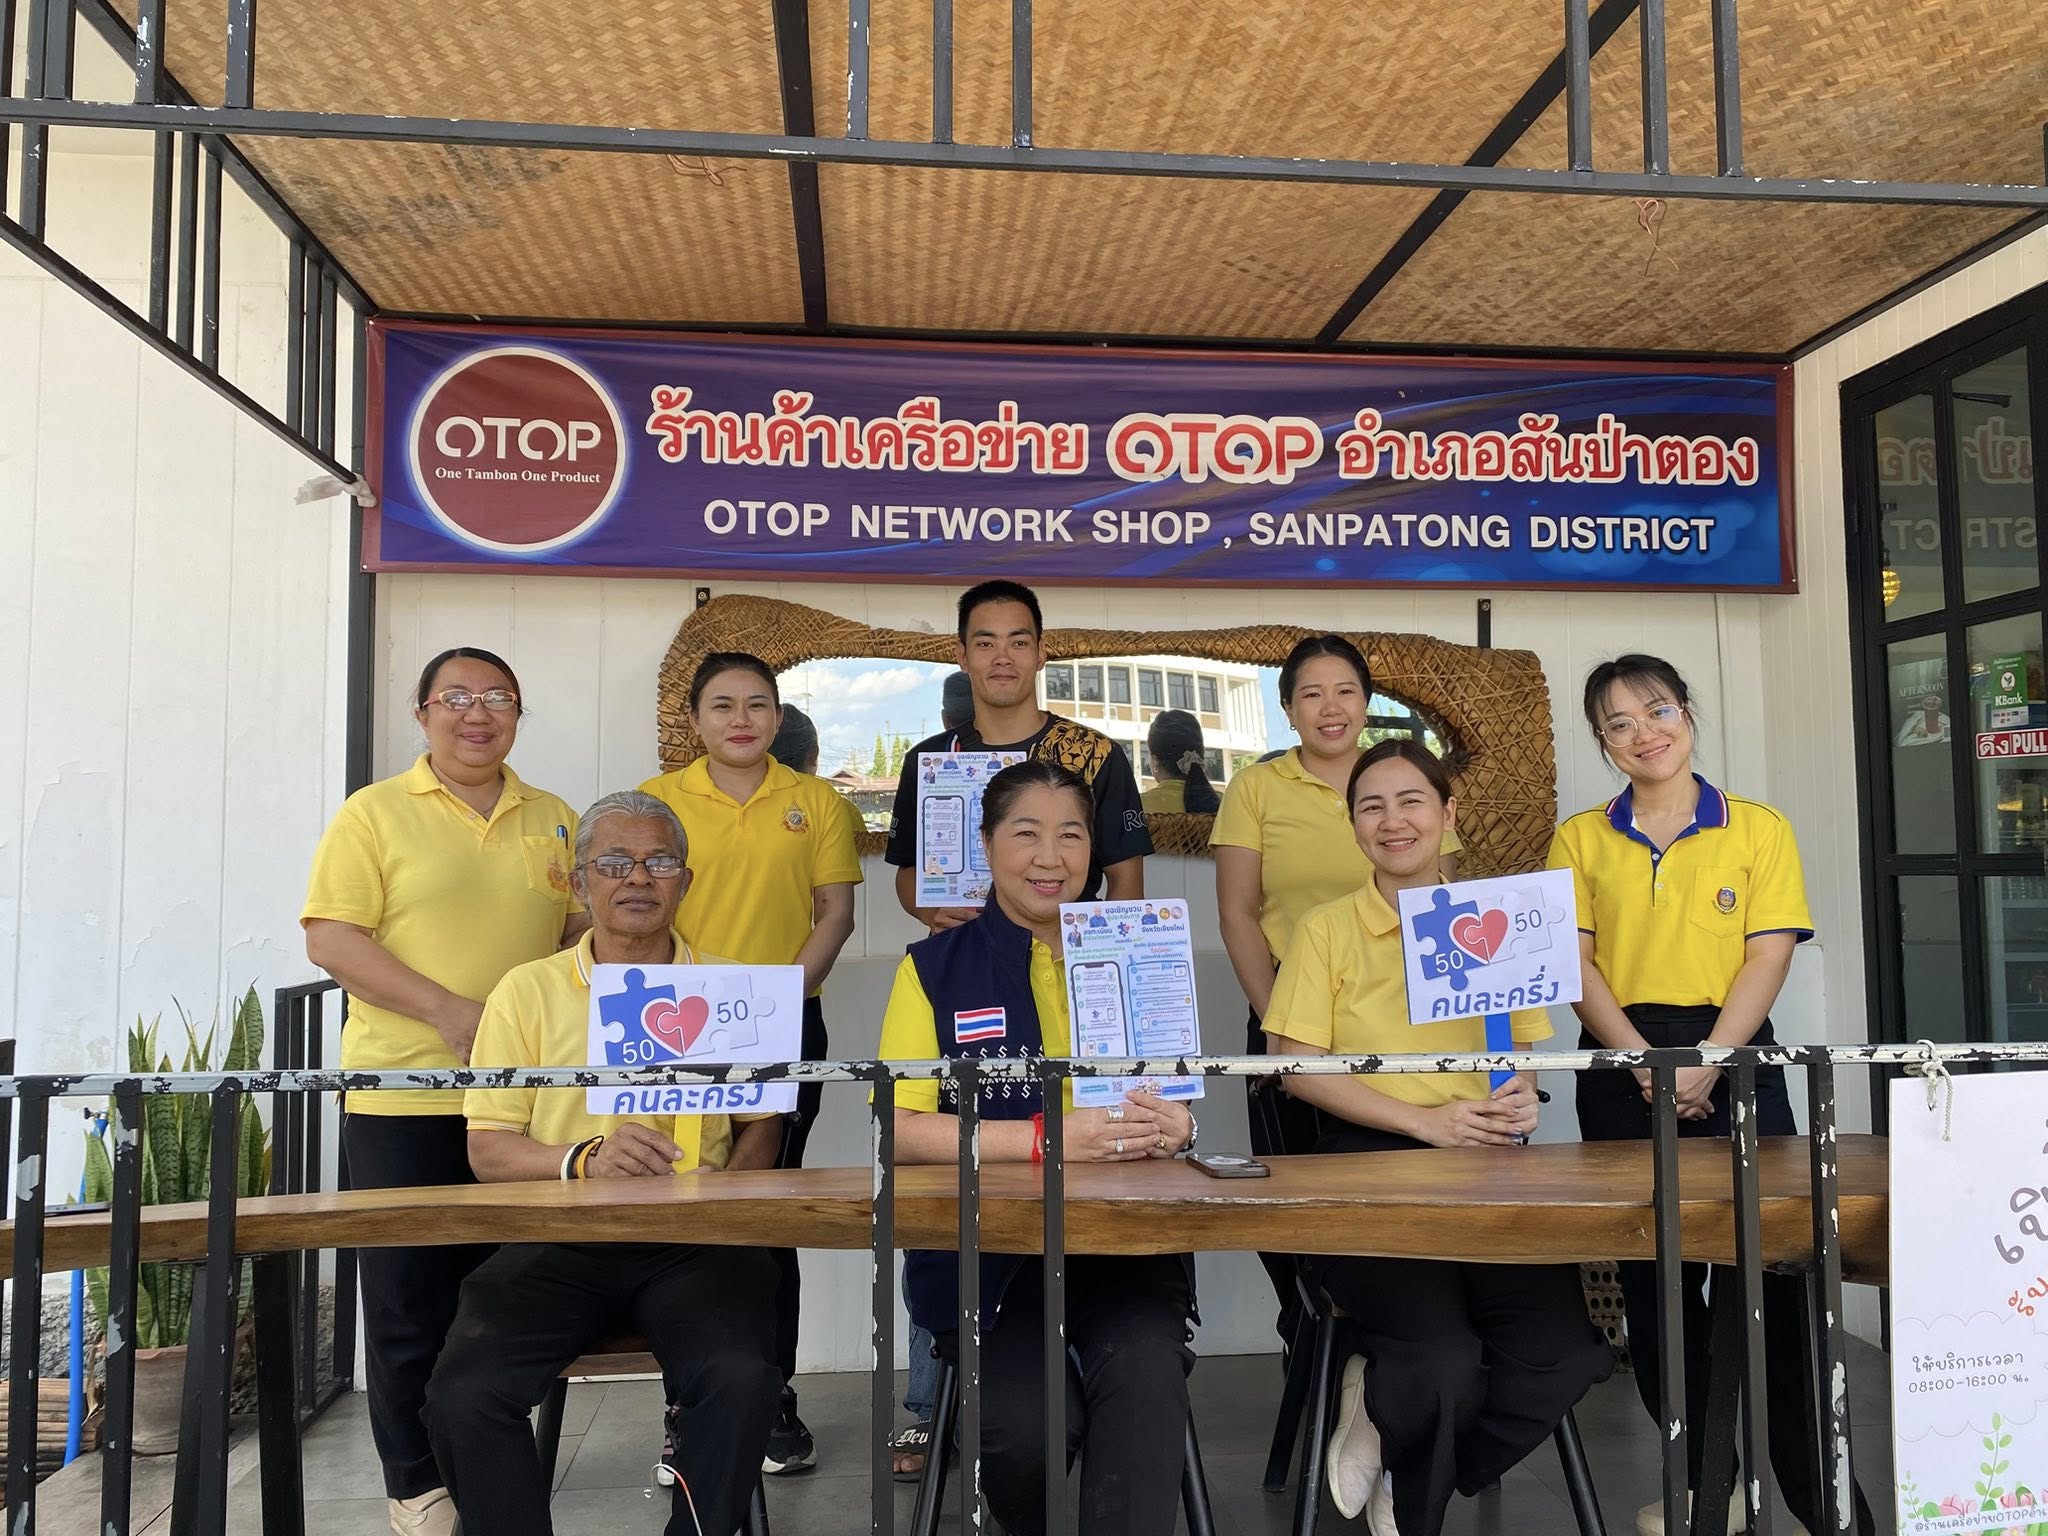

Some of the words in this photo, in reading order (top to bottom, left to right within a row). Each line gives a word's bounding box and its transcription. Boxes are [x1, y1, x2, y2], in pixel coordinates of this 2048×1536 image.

[435, 416, 601, 461] OTOP
[648, 386, 1087, 473] ร้านค้าเครือข่าย
[1108, 415, 1321, 482] OTOP
[1337, 412, 1757, 484] อำเภอสันป่าตอง
[435, 467, 462, 480] One
[465, 468, 518, 481] Tambon
[521, 470, 547, 482] One
[551, 471, 600, 483] Product
[704, 499, 829, 537] OTOP
[851, 505, 1074, 542] NETWORK
[1092, 509, 1211, 545] SHOP
[1249, 512, 1511, 547] SANPATONG
[1530, 517, 1715, 550] DISTRICT
[1995, 692, 2023, 706] KBank
[1979, 735, 2009, 756] ดึง
[2012, 731, 2047, 754] PULL
[1515, 909, 1542, 932] 50
[1435, 950, 1464, 973] 50
[1431, 965, 1560, 1018] คนละครึ่ง
[716, 999, 749, 1024] 50
[622, 1039, 655, 1064] 50
[1912, 1351, 2024, 1373] ให้บริการเวลา
[1908, 1373, 2007, 1393] 08:00-16:00
